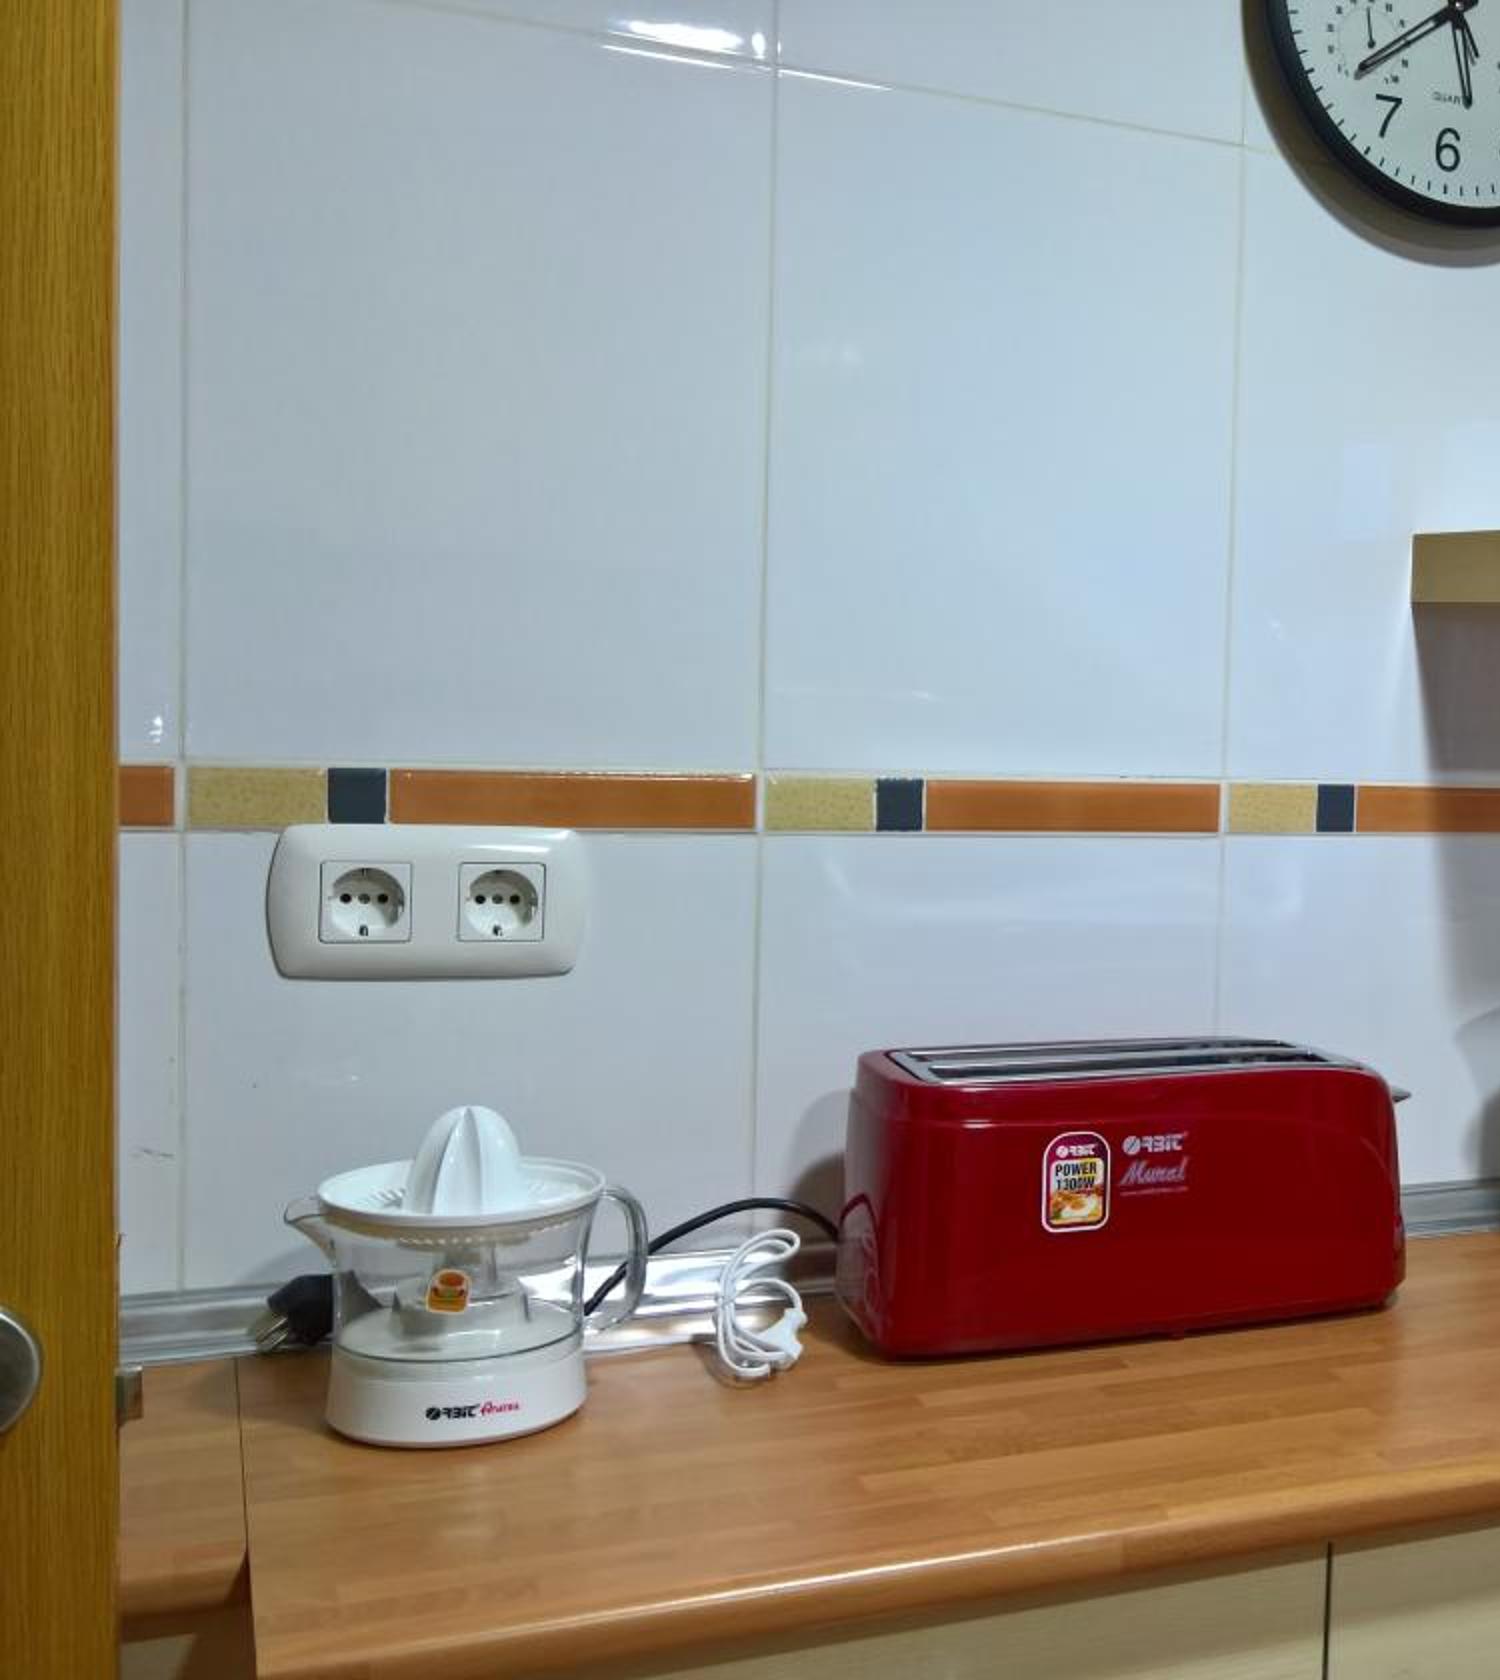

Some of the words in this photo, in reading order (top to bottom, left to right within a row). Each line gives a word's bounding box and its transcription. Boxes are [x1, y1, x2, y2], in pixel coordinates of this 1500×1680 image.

[1375, 93, 1403, 138] 7
[1434, 127, 1461, 172] 6
[1055, 1162, 1097, 1177] POWER
